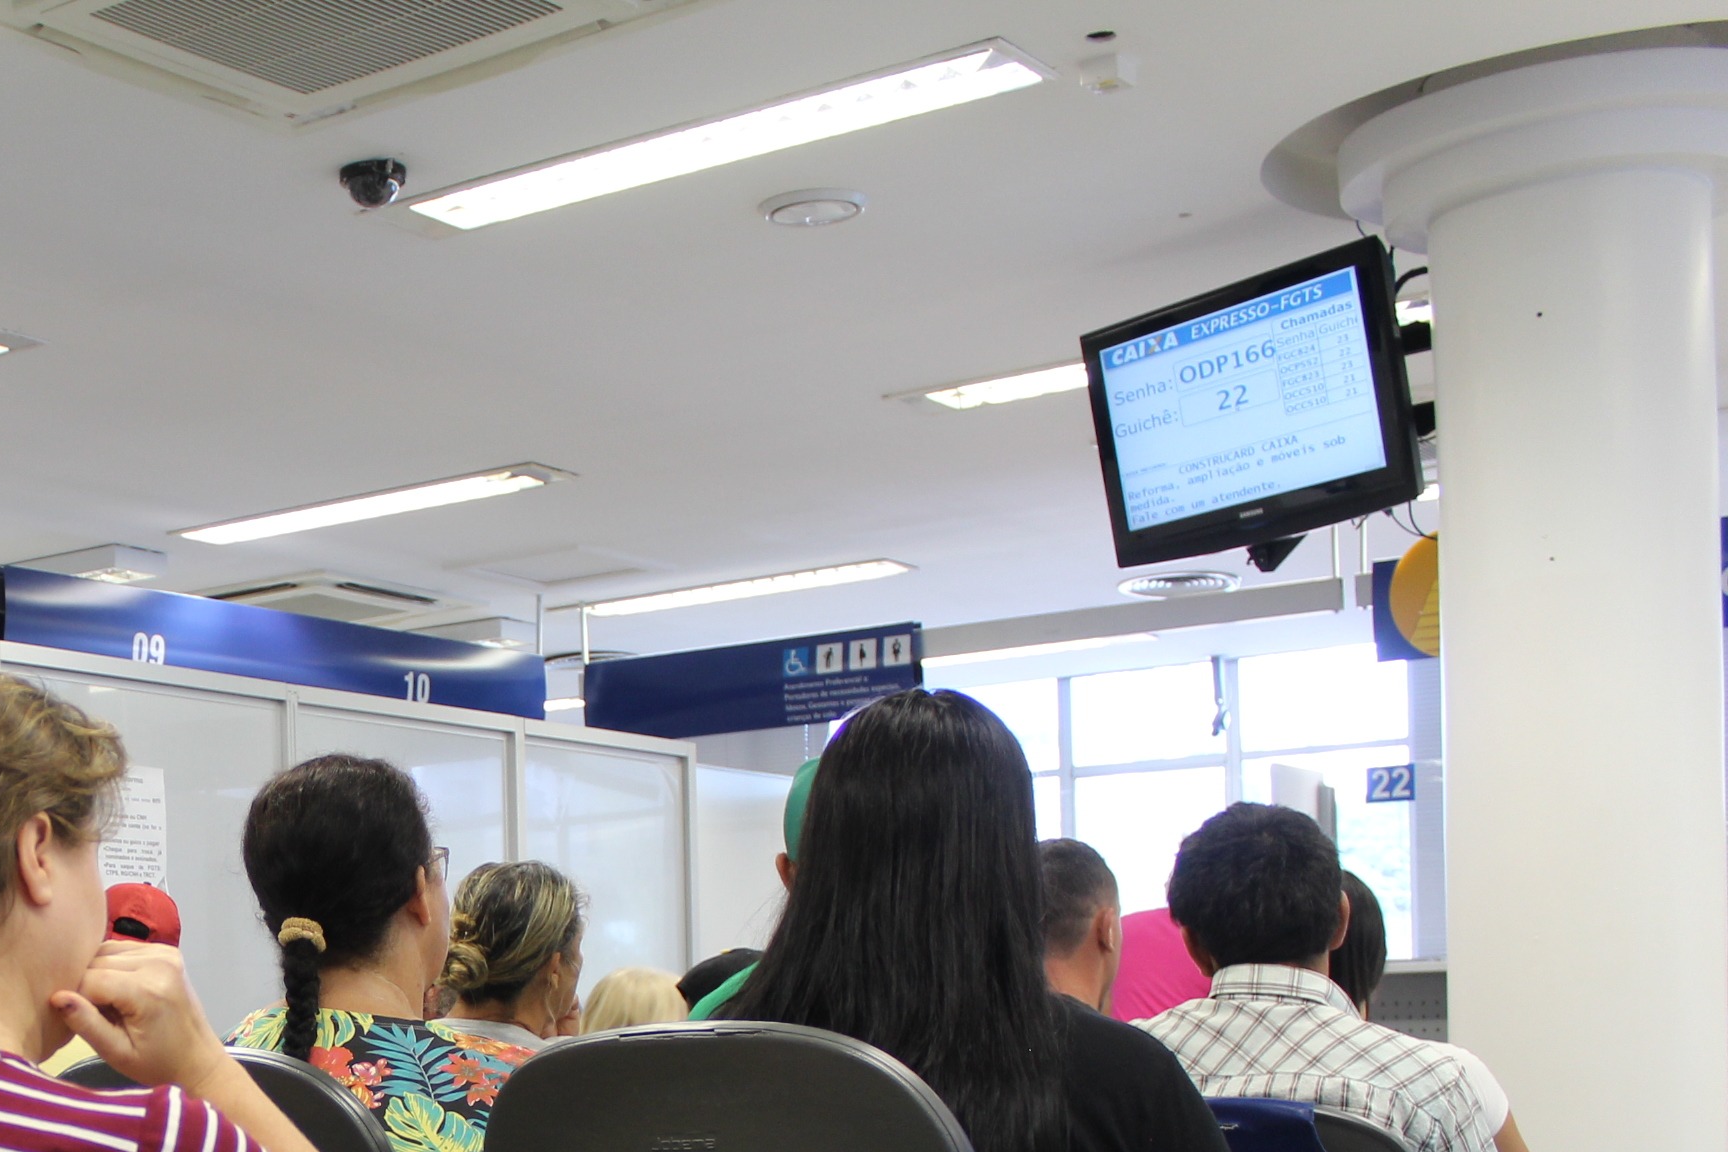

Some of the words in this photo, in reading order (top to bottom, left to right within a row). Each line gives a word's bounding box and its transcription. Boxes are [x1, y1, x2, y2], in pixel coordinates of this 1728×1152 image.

[1111, 332, 1179, 366] CAIXA
[1190, 284, 1323, 341] EXPRESSO-FGTS
[1281, 300, 1353, 330] Chamadas
[1277, 330, 1315, 348] Senha
[1337, 333, 1350, 344] 23
[1339, 346, 1351, 357] 22
[1179, 339, 1277, 385] ODP166
[1342, 360, 1354, 371] 23
[1114, 376, 1173, 407] Senha:
[1343, 374, 1356, 384] 21
[1346, 387, 1358, 397] 21
[1215, 384, 1250, 412] 22
[1115, 409, 1180, 440] Guichê:
[1178, 446, 1256, 474] CONSTRUCARD
[1262, 434, 1299, 453] CAIXA
[1187, 461, 1251, 486] ampliação
[1256, 456, 1264, 468] e
[1271, 443, 1316, 464] móveis
[1323, 434, 1346, 449] sob
[1132, 510, 1158, 526] Fale
[1164, 504, 1185, 517] com
[1191, 498, 1206, 509] um
[132, 631, 166, 665] 09
[404, 671, 430, 705] 10
[1371, 767, 1411, 799] 22
